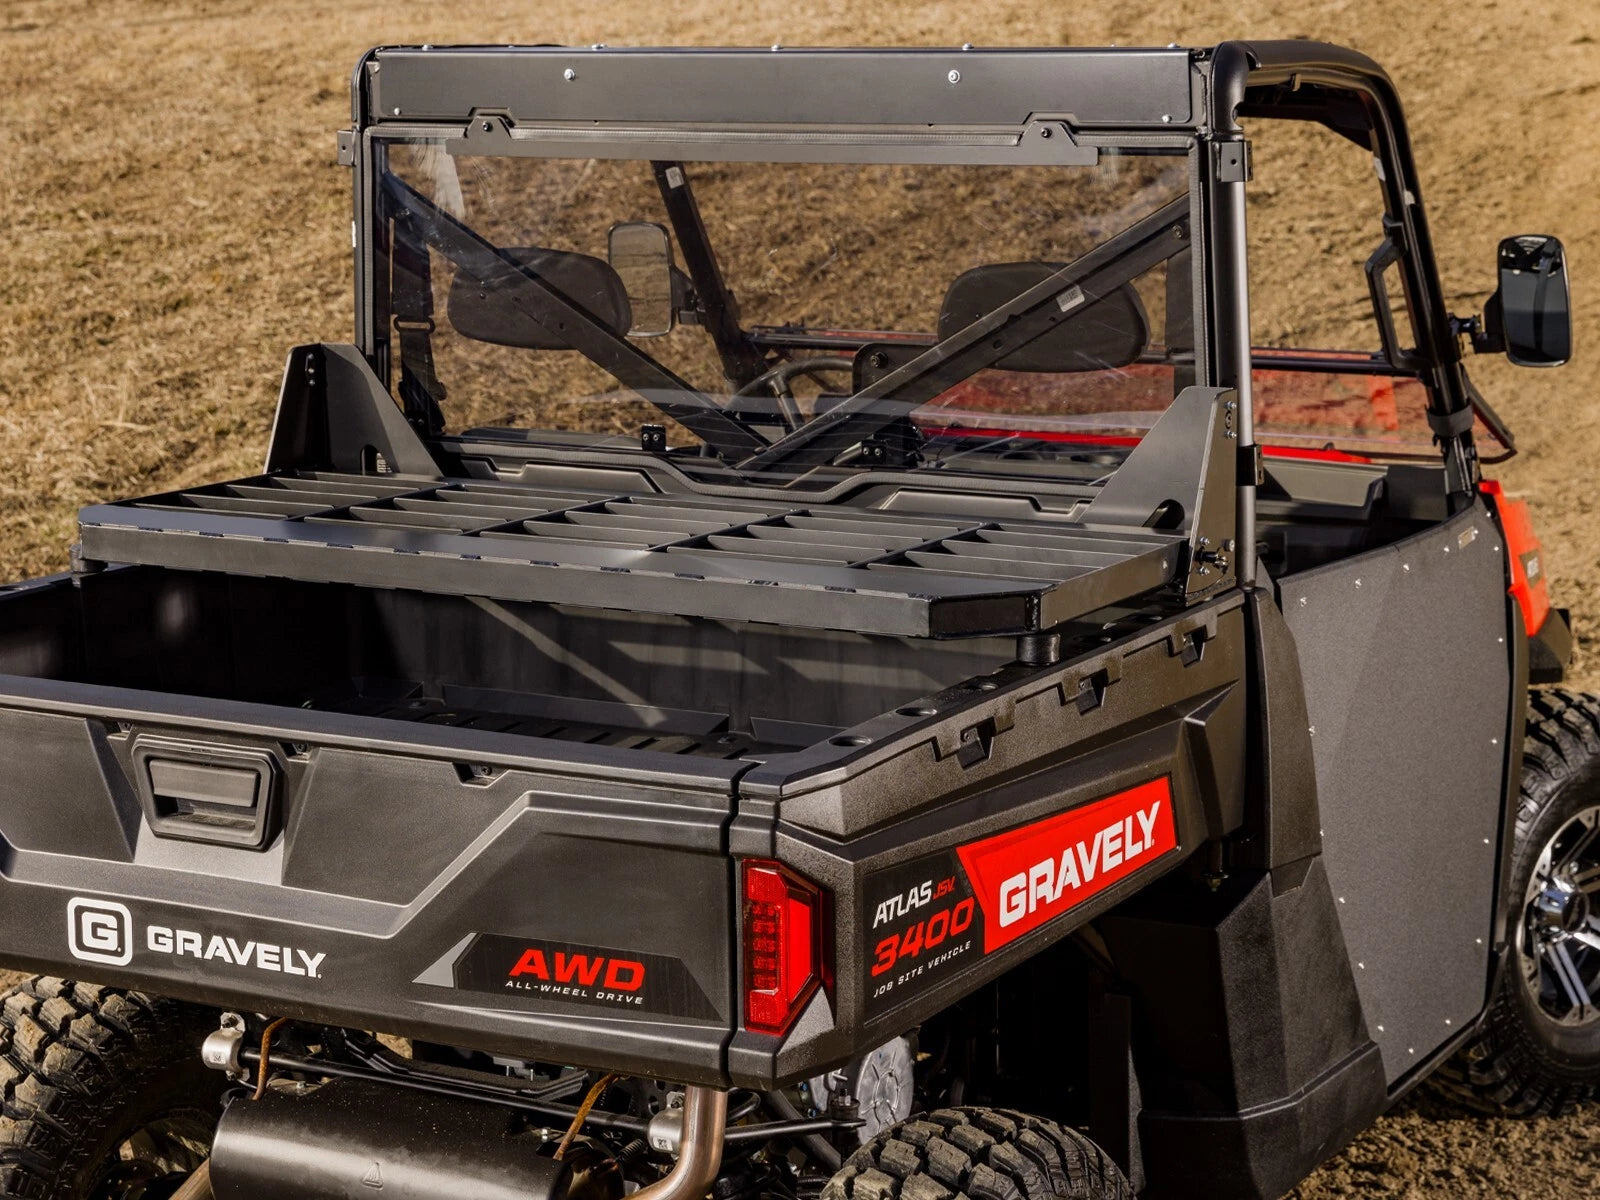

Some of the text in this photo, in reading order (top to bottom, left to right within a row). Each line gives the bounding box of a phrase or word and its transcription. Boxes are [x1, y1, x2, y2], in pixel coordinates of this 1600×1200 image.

[1000, 801, 1160, 928] GRAVELY
[872, 876, 956, 929] ATLAS JSV
[147, 925, 326, 978] GRAVELY
[871, 896, 975, 977] 3400
[505, 980, 643, 1005] ALL-WHEEL DRIVE
[509, 949, 646, 991] AWD
[873, 940, 971, 998] JOB SITE VEHICLE
